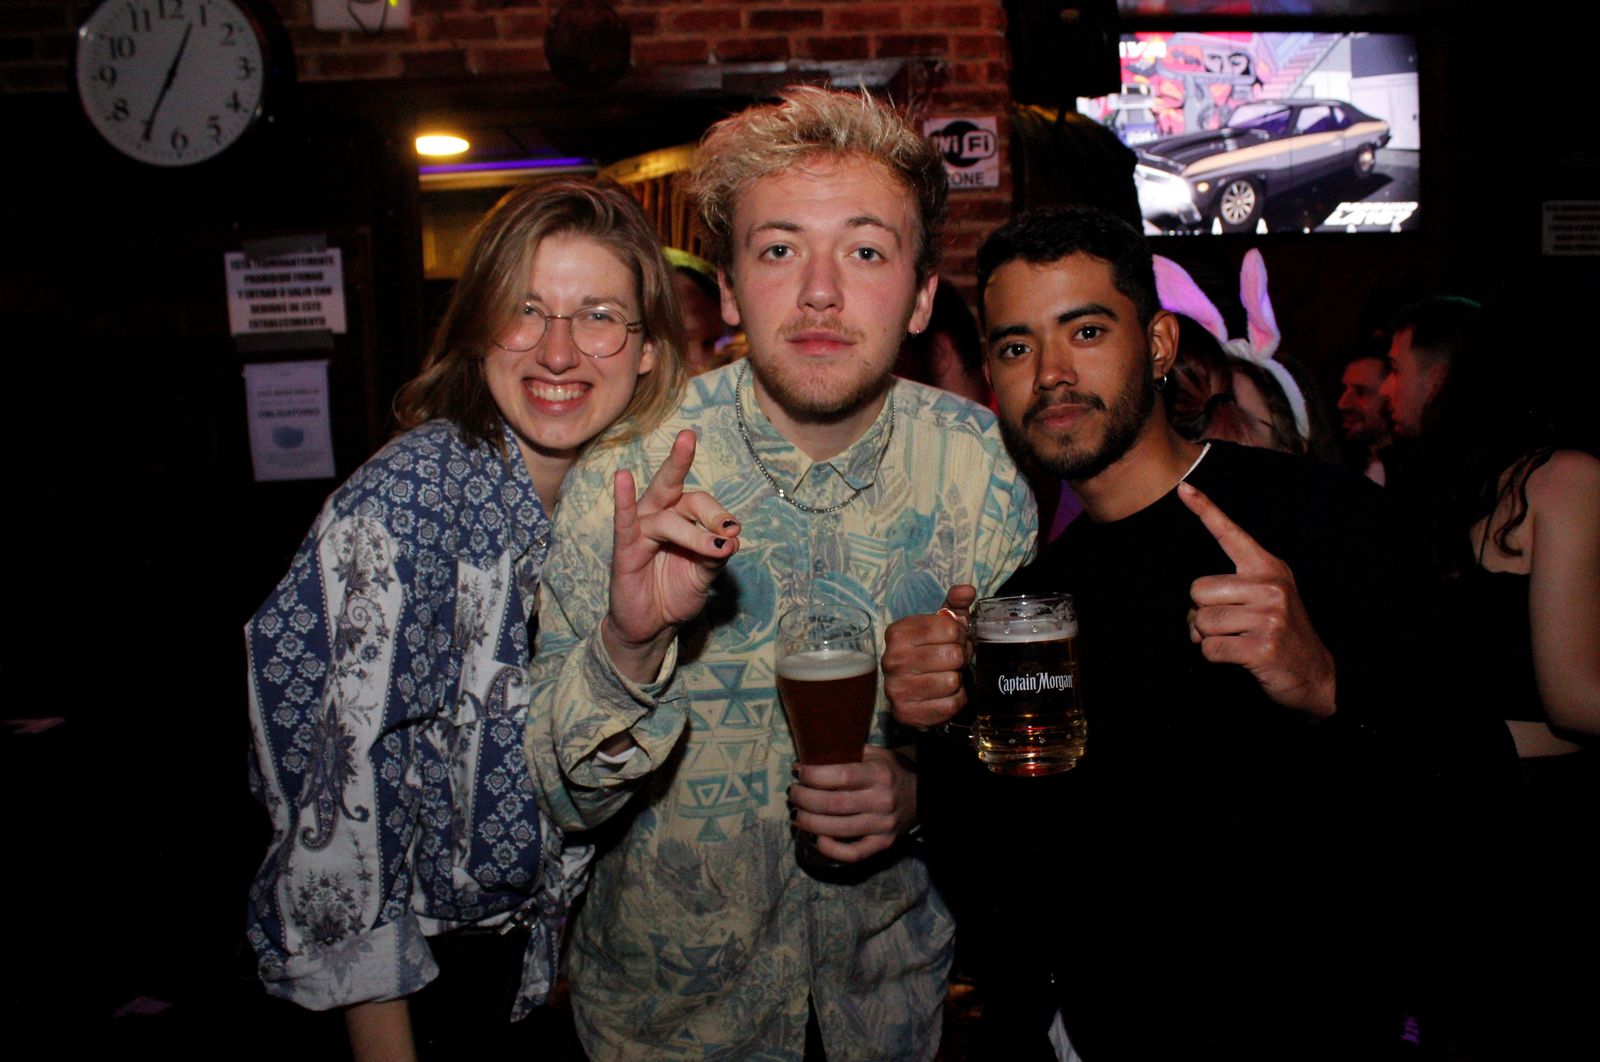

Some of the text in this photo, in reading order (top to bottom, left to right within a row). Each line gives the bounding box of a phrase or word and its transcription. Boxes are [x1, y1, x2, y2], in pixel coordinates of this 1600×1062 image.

[127, 2, 150, 31] 11
[158, 0, 183, 19] 12
[198, 6, 207, 26] 1
[220, 22, 236, 46] 2
[108, 36, 136, 59] 10
[99, 65, 117, 88] 9
[238, 56, 255, 80] 3
[112, 98, 130, 122] 8
[226, 90, 241, 112] 4
[170, 126, 188, 152] 6
[207, 115, 222, 144] 5
[950, 172, 985, 185] ONE
[998, 672, 1073, 695] Captain Morgan
